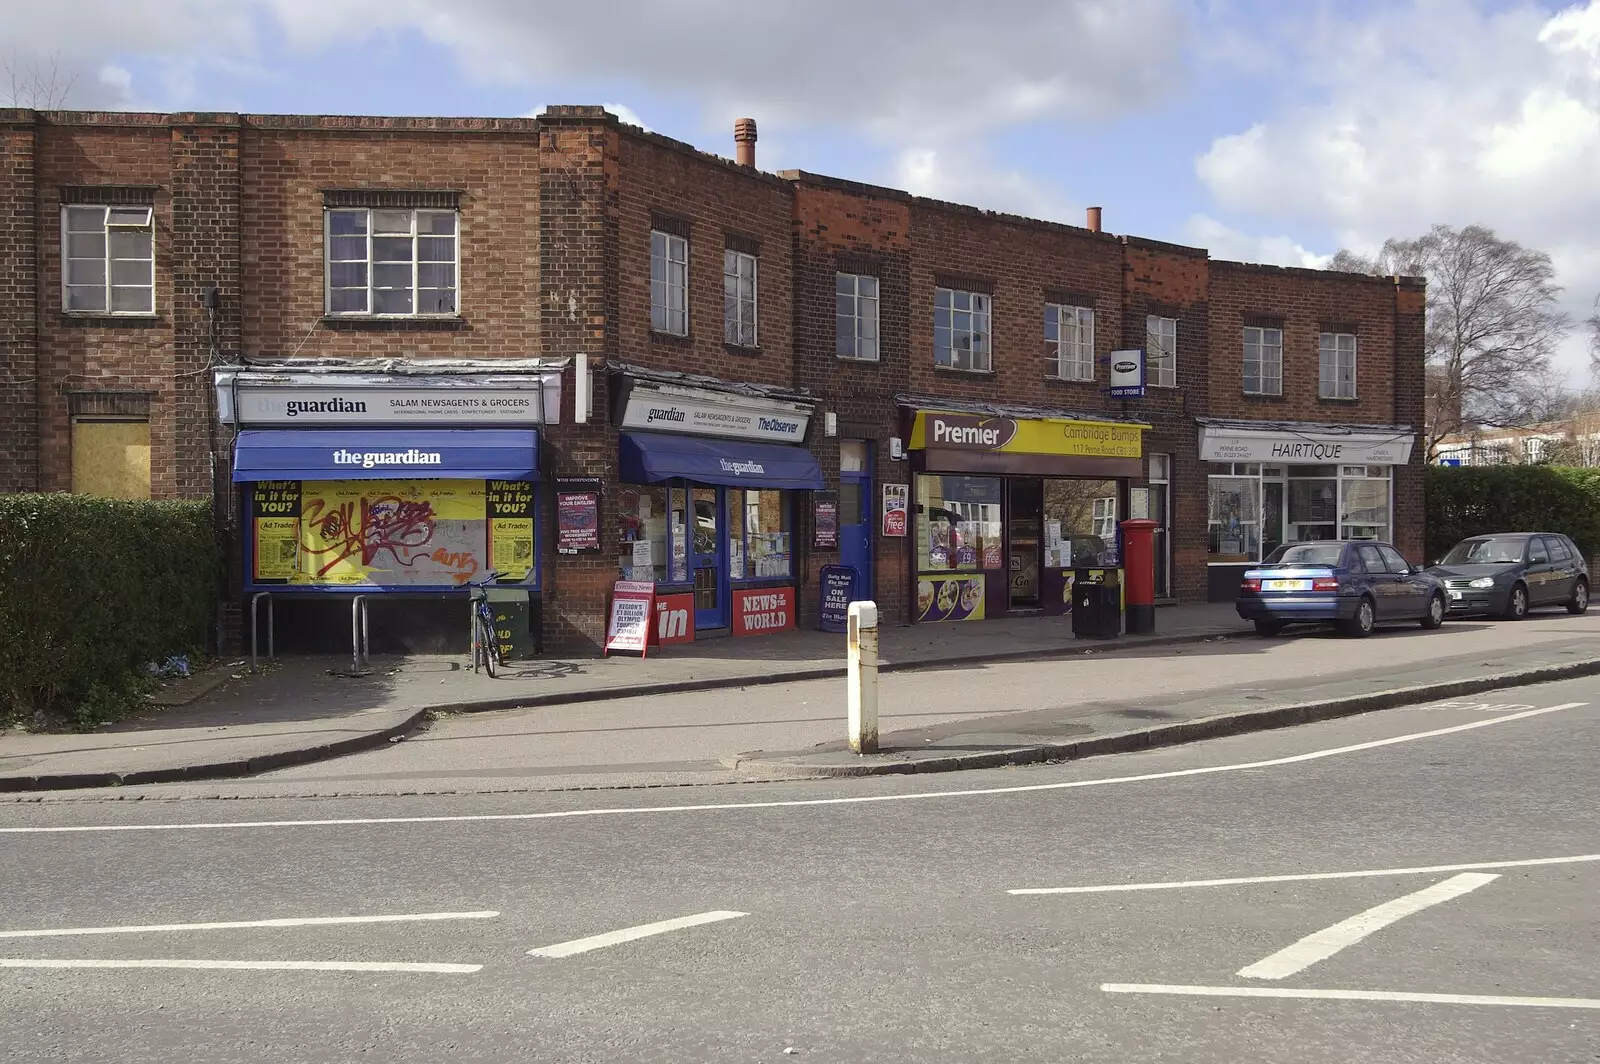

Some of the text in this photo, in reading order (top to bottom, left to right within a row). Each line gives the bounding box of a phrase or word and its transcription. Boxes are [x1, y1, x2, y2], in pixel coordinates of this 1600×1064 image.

[286, 397, 367, 417] guardian
[389, 399, 530, 407] SALAM NEWSAGENTS & GROCERS
[934, 419, 1000, 445] Premier
[1063, 424, 1139, 444] Cambridge Bumps
[1271, 443, 1342, 460] HAIRTIQUE
[491, 481, 531, 491] What's
[254, 491, 299, 501] in it for
[489, 491, 533, 502] in it for
[260, 502, 294, 512] YOU?
[495, 503, 528, 513] YOU?
[615, 583, 638, 591] Evening
[742, 594, 778, 612] NEWS
[825, 595, 848, 603] SALE
[619, 603, 643, 611] REGION'S
[617, 615, 641, 623] OLYMPIC
[742, 611, 788, 631] WORLD
